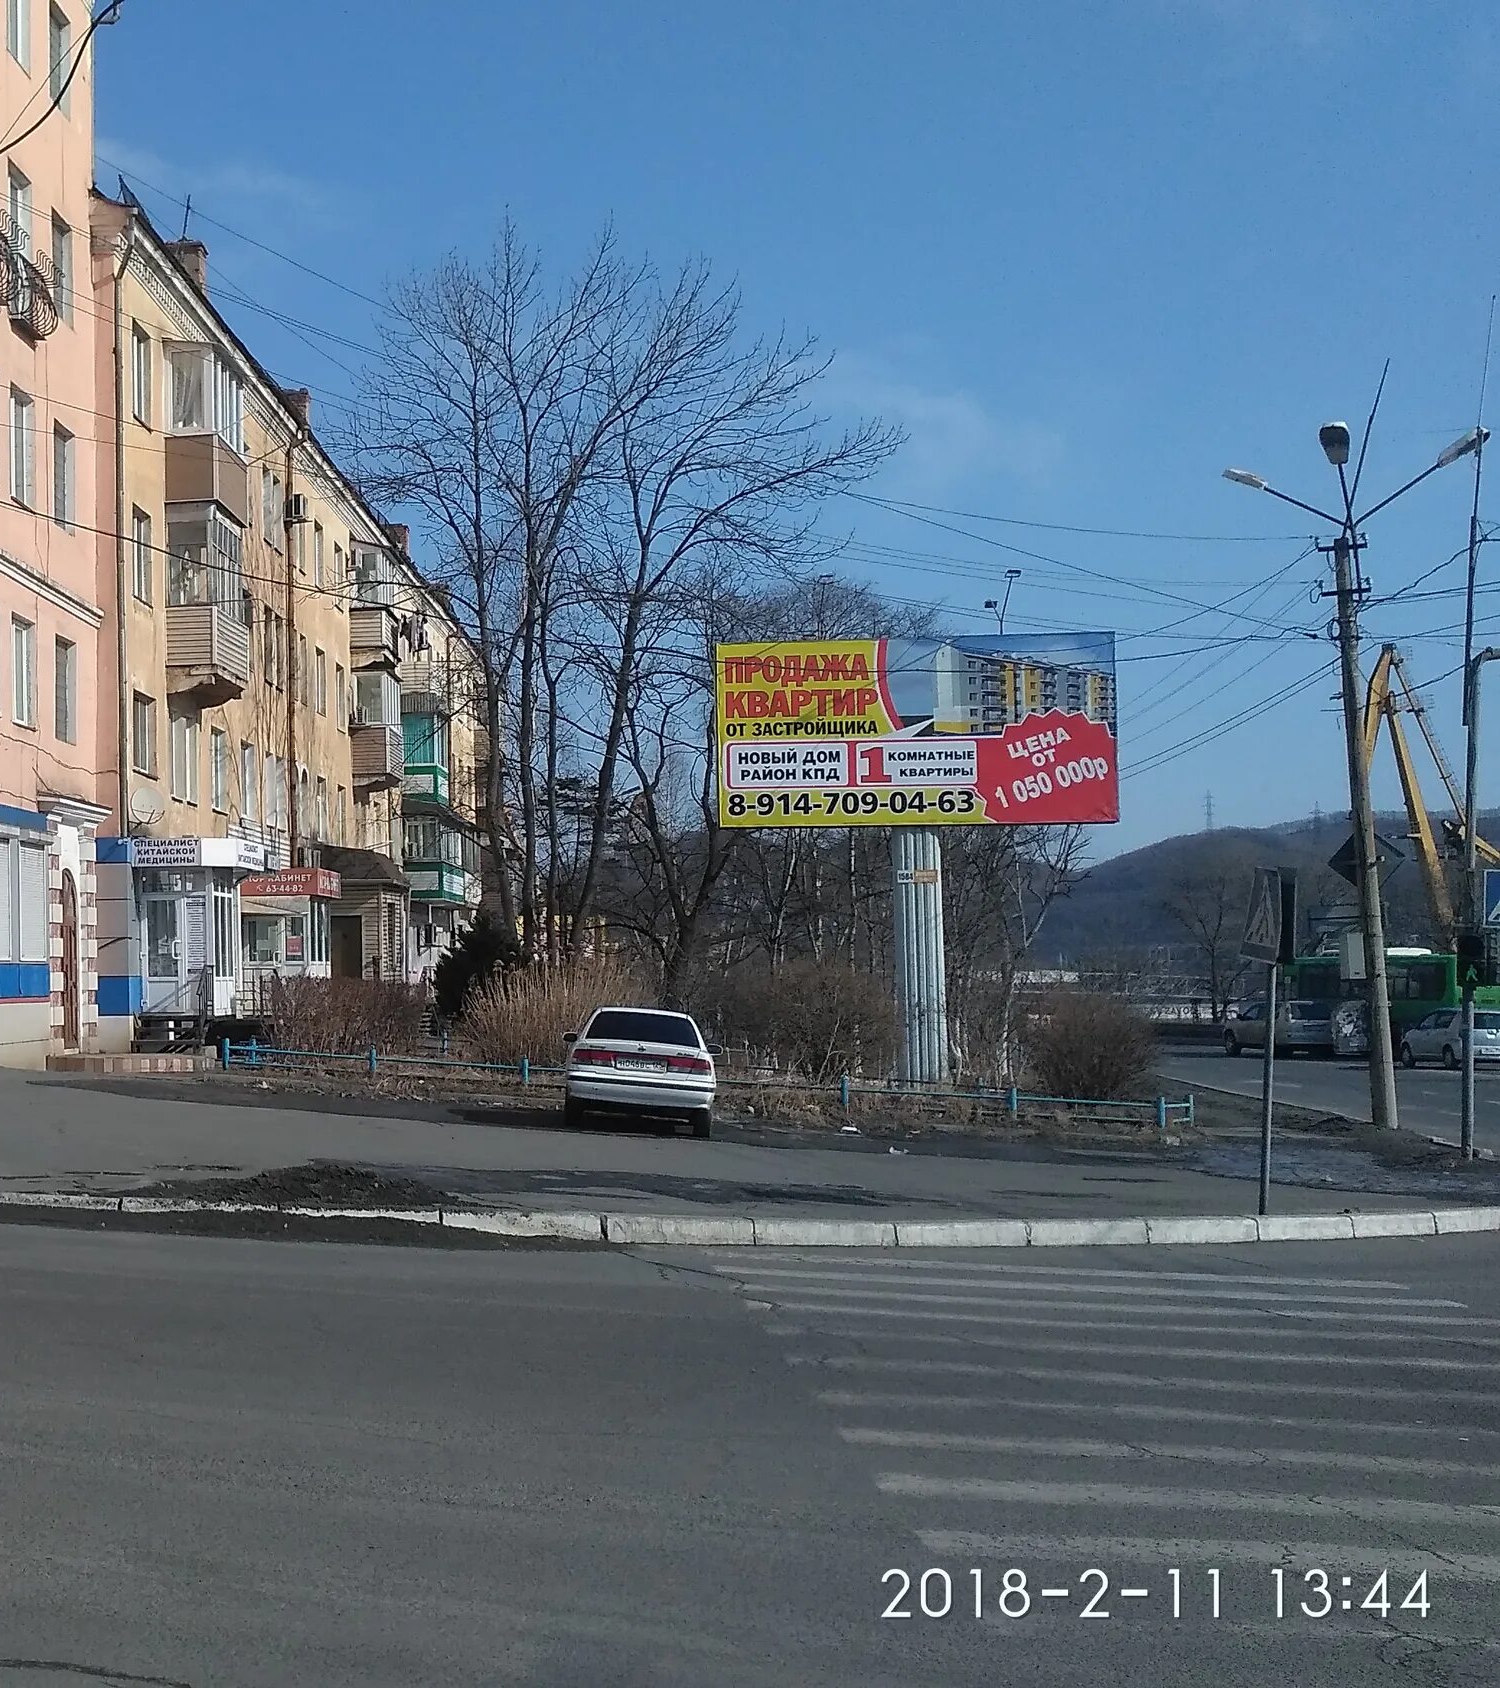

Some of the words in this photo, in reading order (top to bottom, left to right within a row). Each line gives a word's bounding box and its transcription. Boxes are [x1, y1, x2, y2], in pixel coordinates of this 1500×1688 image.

[724, 653, 870, 687] ПРОДАЖА
[724, 688, 881, 720] КВАРТИР
[726, 722, 747, 738] ОТ
[752, 719, 879, 739] ЗАСТРОЙЩИКА
[1006, 726, 1073, 760] ЦЕНА
[737, 748, 799, 765] НОВЫЙ
[802, 750, 842, 766] ДОМ
[858, 746, 893, 784] 1
[887, 749, 975, 762] КОМНАТНЫЕ
[1031, 747, 1057, 768] ОТ
[740, 765, 797, 781] РАЙОН
[801, 767, 841, 783] КПД
[899, 766, 975, 778] КВАРТИРЫ
[994, 785, 1009, 809] 1
[1011, 770, 1053, 803] 050
[727, 788, 976, 818] 8-914-709-04-63
[133, 839, 199, 848] СПЕЦИАЛИСТ
[137, 847, 196, 856] КИТАЙСКОЙ
[137, 857, 196, 866] МЕДИЦИНЫ
[266, 884, 304, 893] 63-44-82
